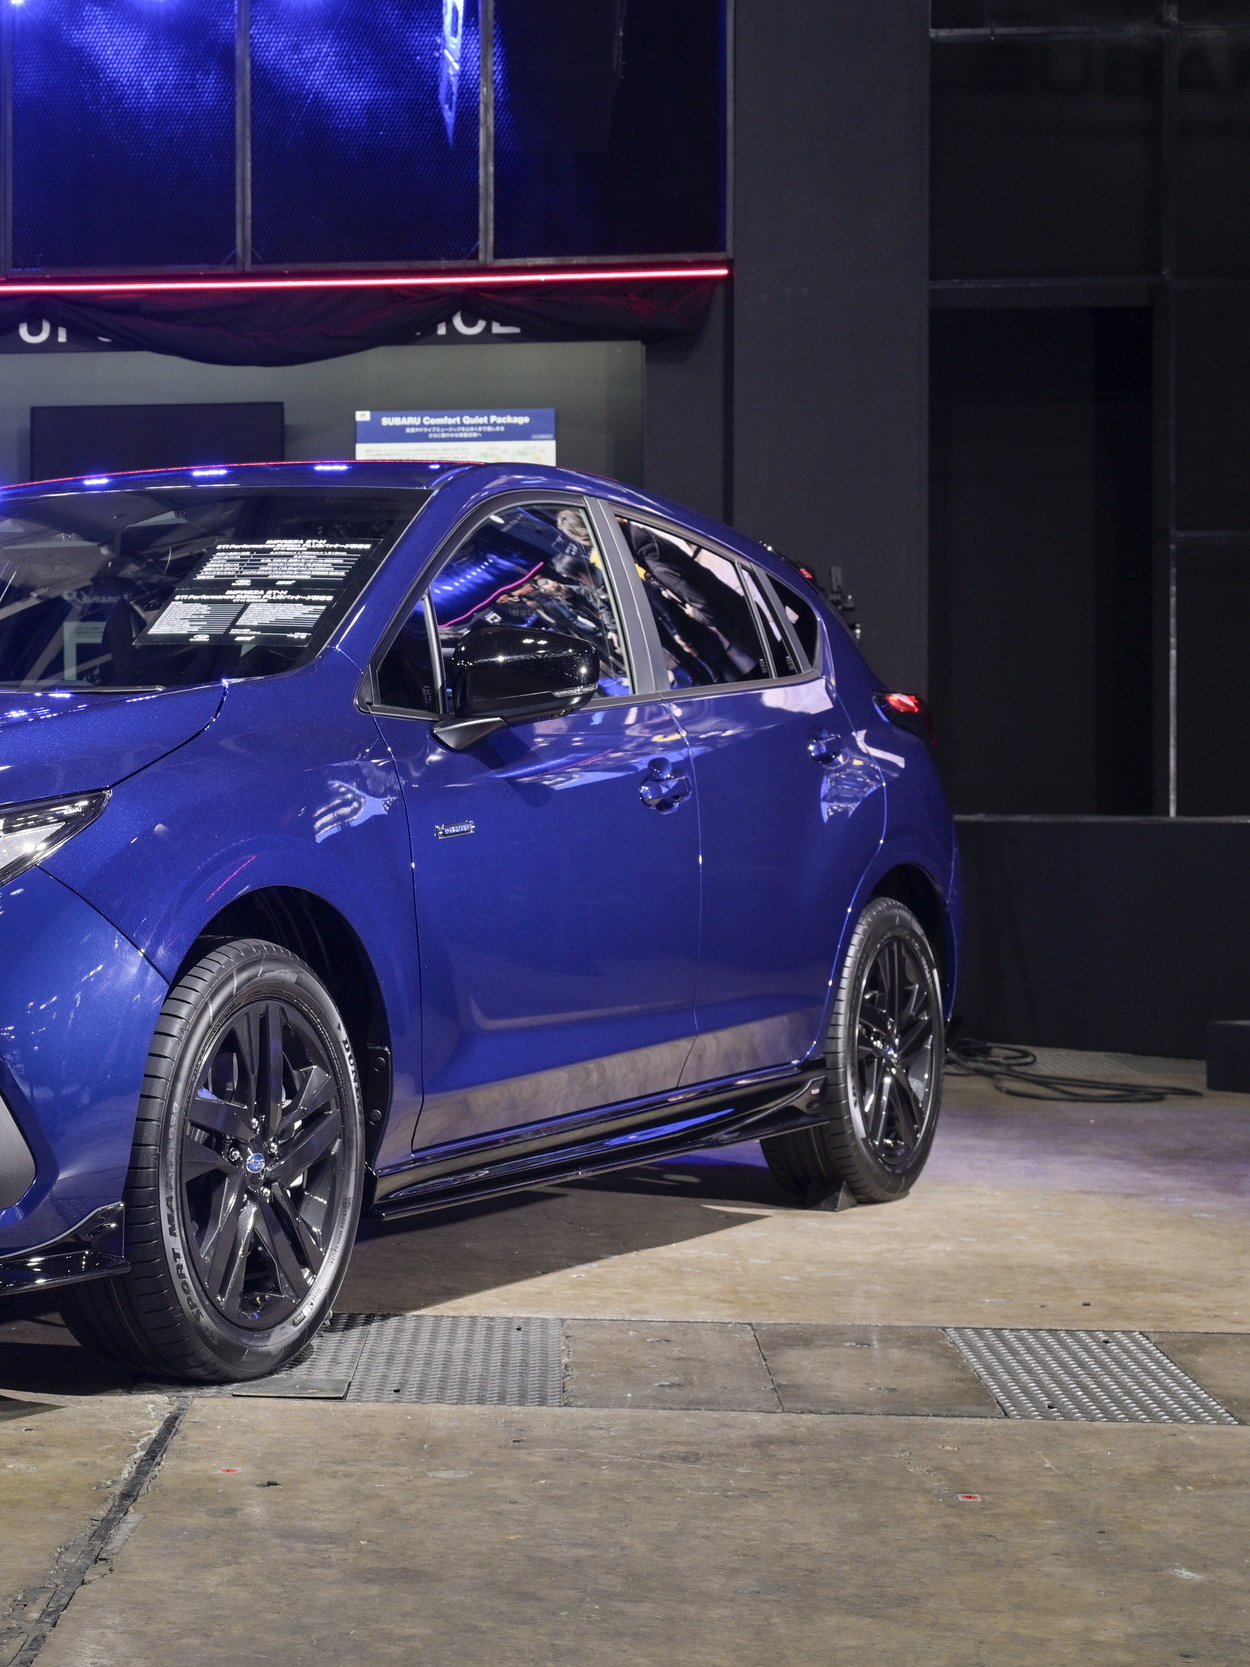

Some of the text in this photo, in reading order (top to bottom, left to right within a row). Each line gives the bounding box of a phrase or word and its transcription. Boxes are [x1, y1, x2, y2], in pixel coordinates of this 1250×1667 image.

[381, 414, 530, 427] SUBARU Comfort Quiet Package
[171, 1247, 205, 1324] SPORT
